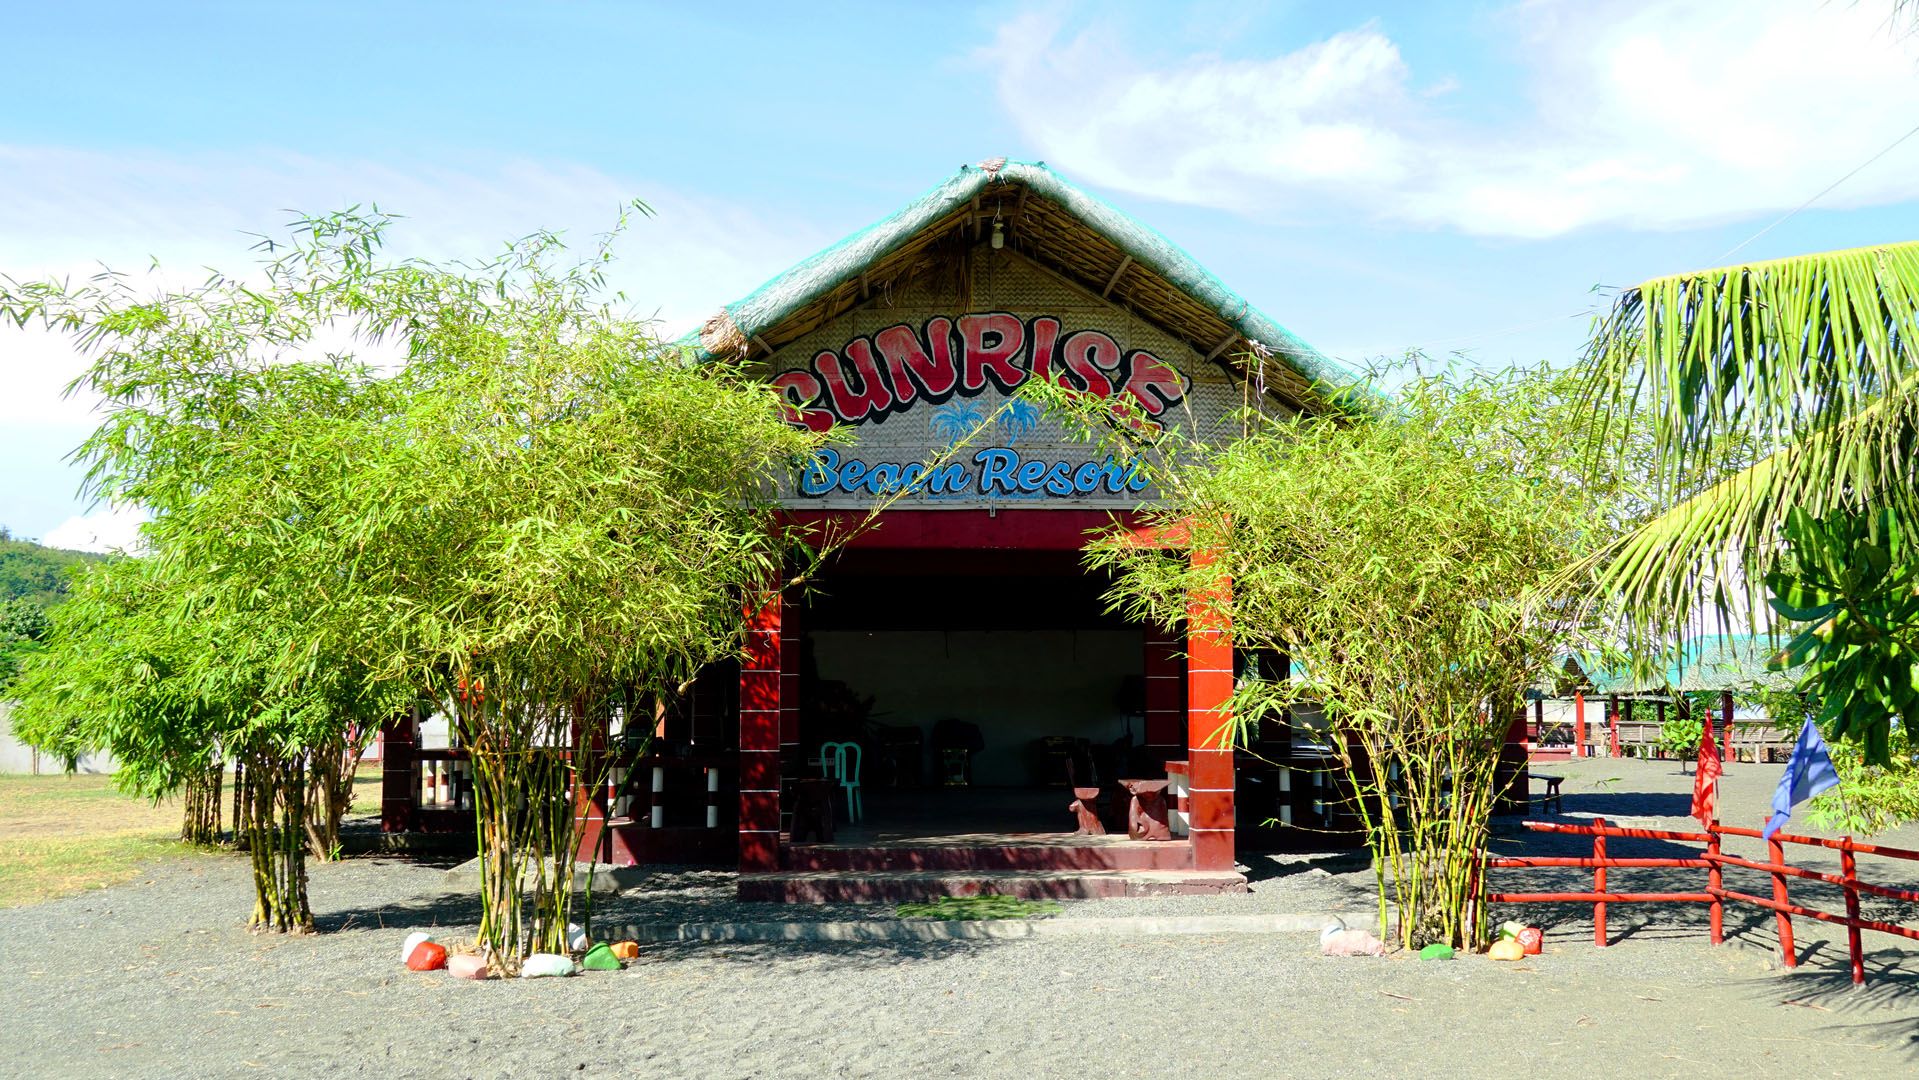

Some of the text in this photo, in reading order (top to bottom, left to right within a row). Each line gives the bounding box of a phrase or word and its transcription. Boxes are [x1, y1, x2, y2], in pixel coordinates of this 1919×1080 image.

[770, 313, 1190, 440] SUNRISE
[801, 446, 1152, 497] Beach Resort
